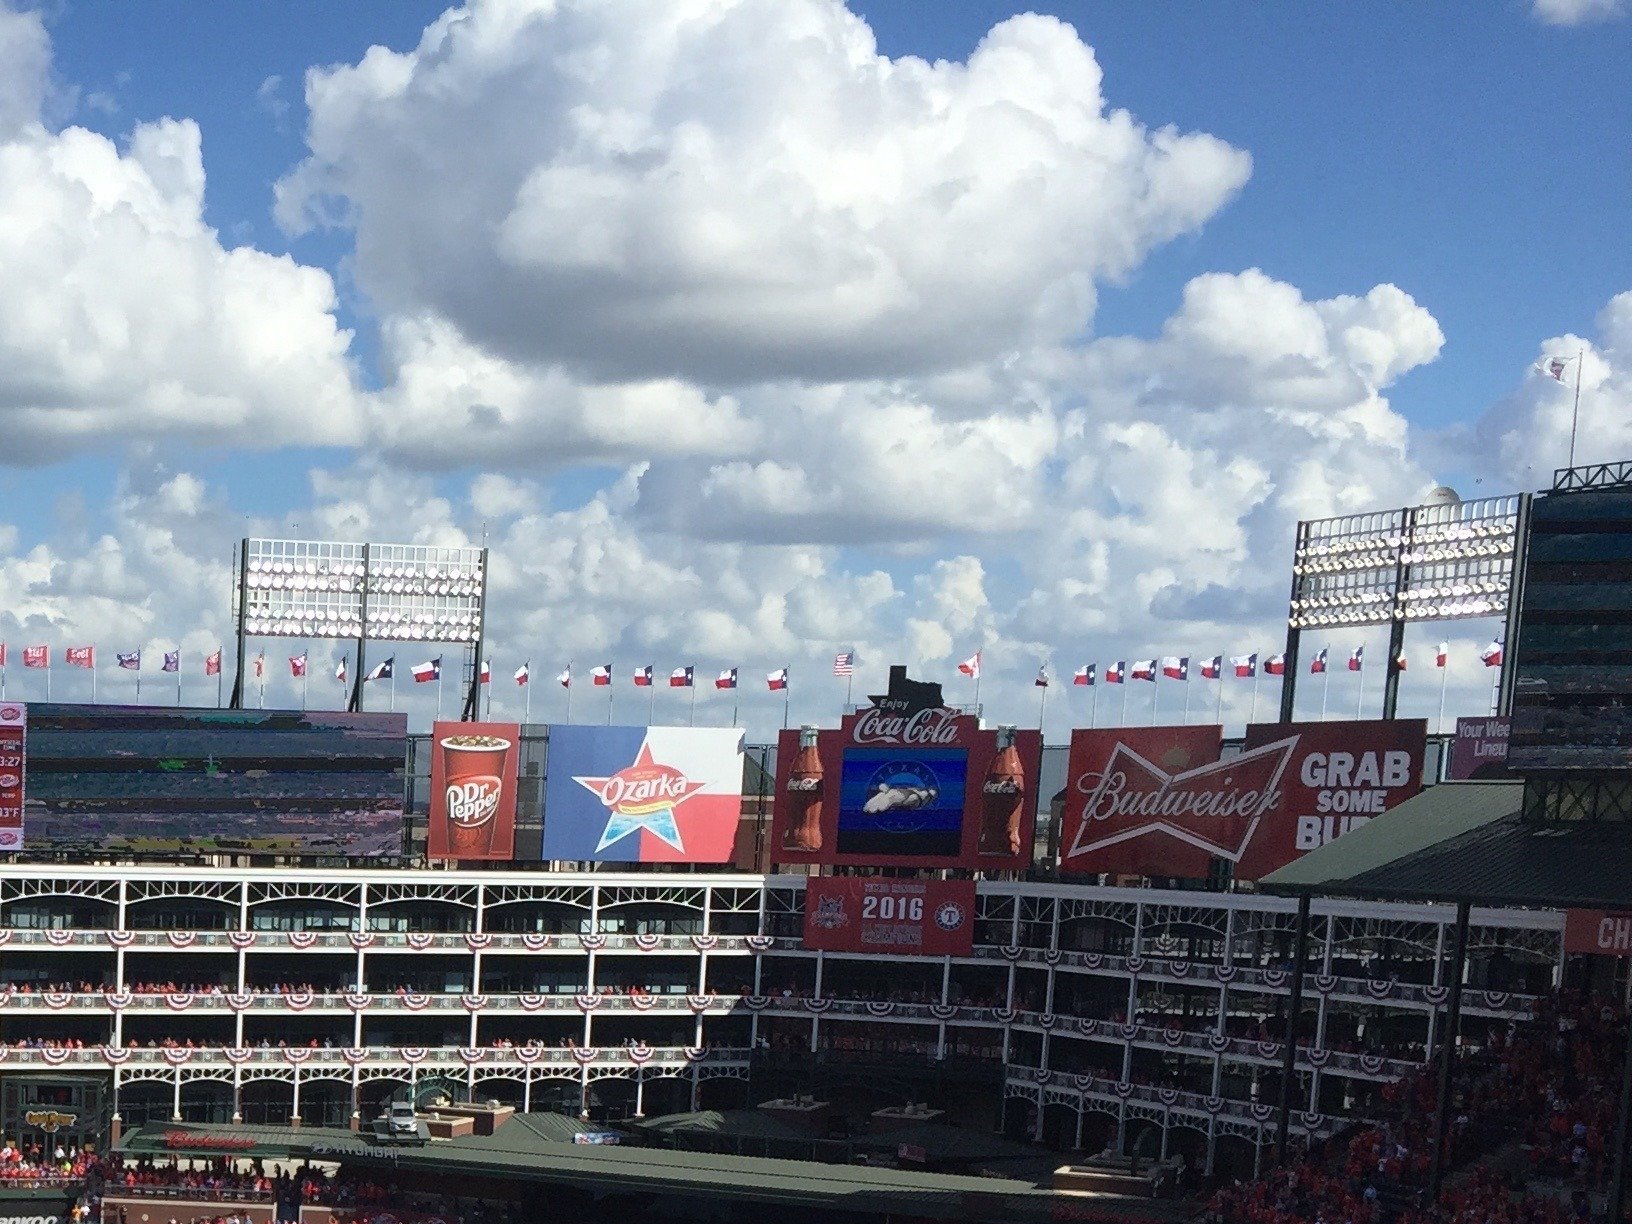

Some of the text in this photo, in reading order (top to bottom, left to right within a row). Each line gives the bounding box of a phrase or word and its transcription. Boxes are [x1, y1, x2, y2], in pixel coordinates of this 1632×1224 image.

[879, 698, 910, 711] Enjoy
[853, 707, 963, 744] Coca-Cola
[1300, 750, 1411, 788] GRAB
[447, 785, 500, 823] Pepper
[464, 783, 489, 804] Dr
[601, 773, 687, 806] Ozarka
[1077, 772, 1281, 821] Budweiser
[1316, 789, 1388, 813] SOME
[862, 896, 924, 921] 2016
